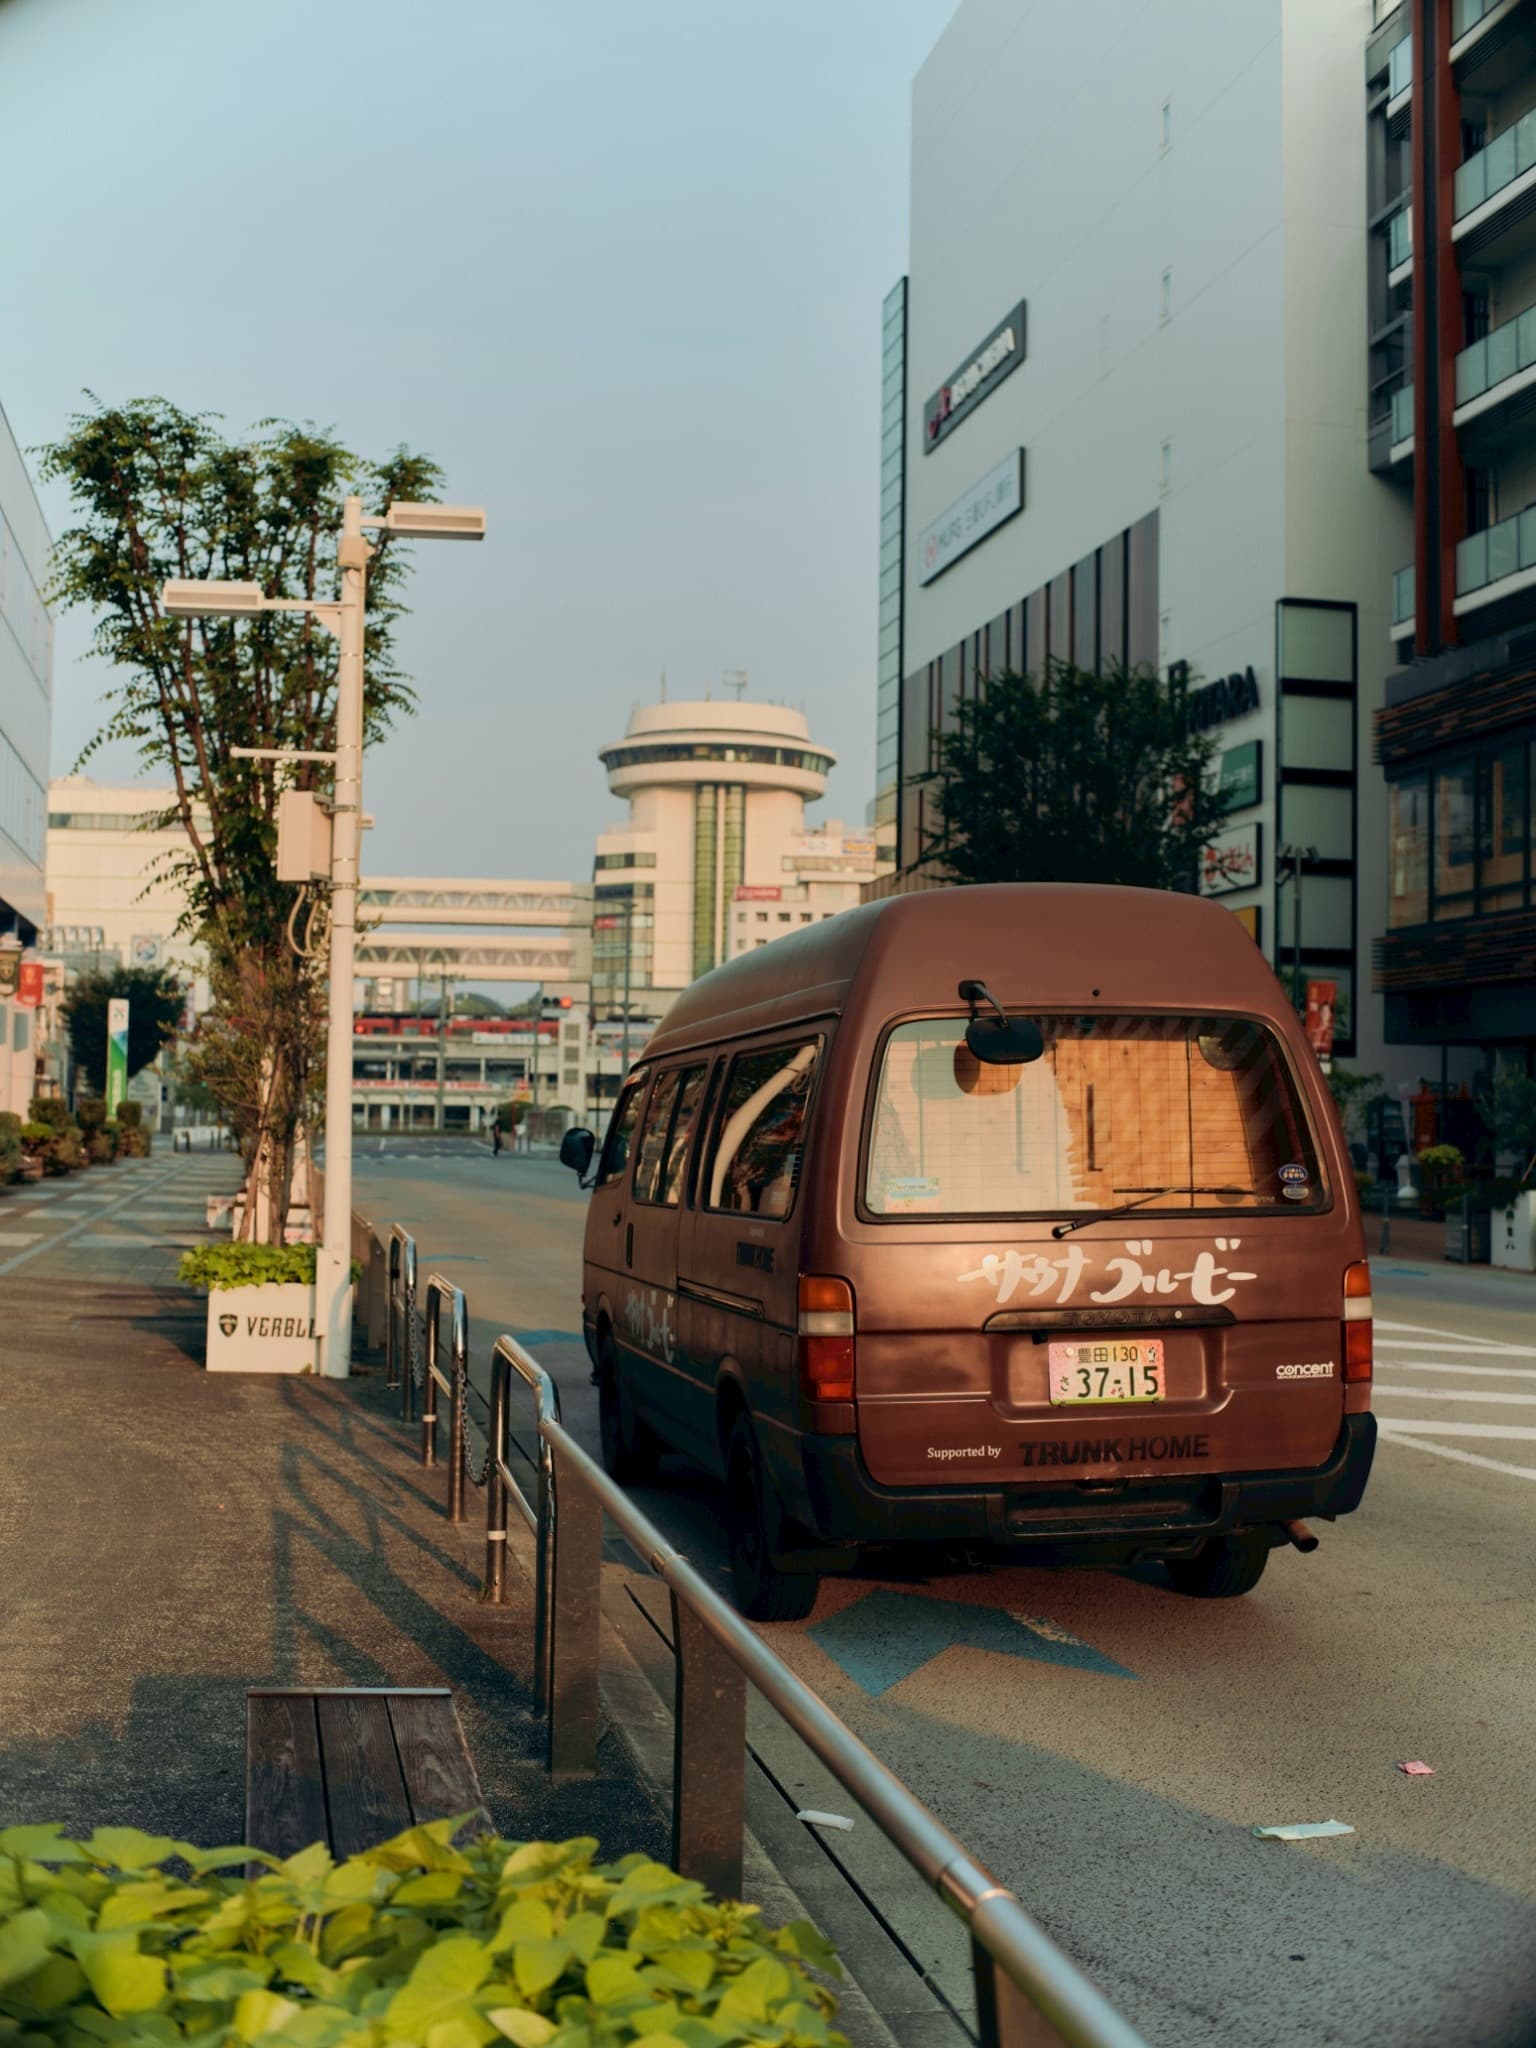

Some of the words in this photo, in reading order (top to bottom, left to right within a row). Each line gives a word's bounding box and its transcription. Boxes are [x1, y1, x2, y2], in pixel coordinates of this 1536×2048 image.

[1064, 1311, 1161, 1328] TOYOTA
[1078, 1347, 1108, 1363] 豊田
[1113, 1346, 1138, 1362] 130
[1276, 1361, 1335, 1376] concent
[1060, 1376, 1069, 1392] さ
[1076, 1365, 1159, 1398] 37-15
[927, 1447, 985, 1460] Supported
[987, 1445, 1002, 1459] by
[1018, 1438, 1124, 1467] TRUNK
[1128, 1434, 1210, 1460] HOME
